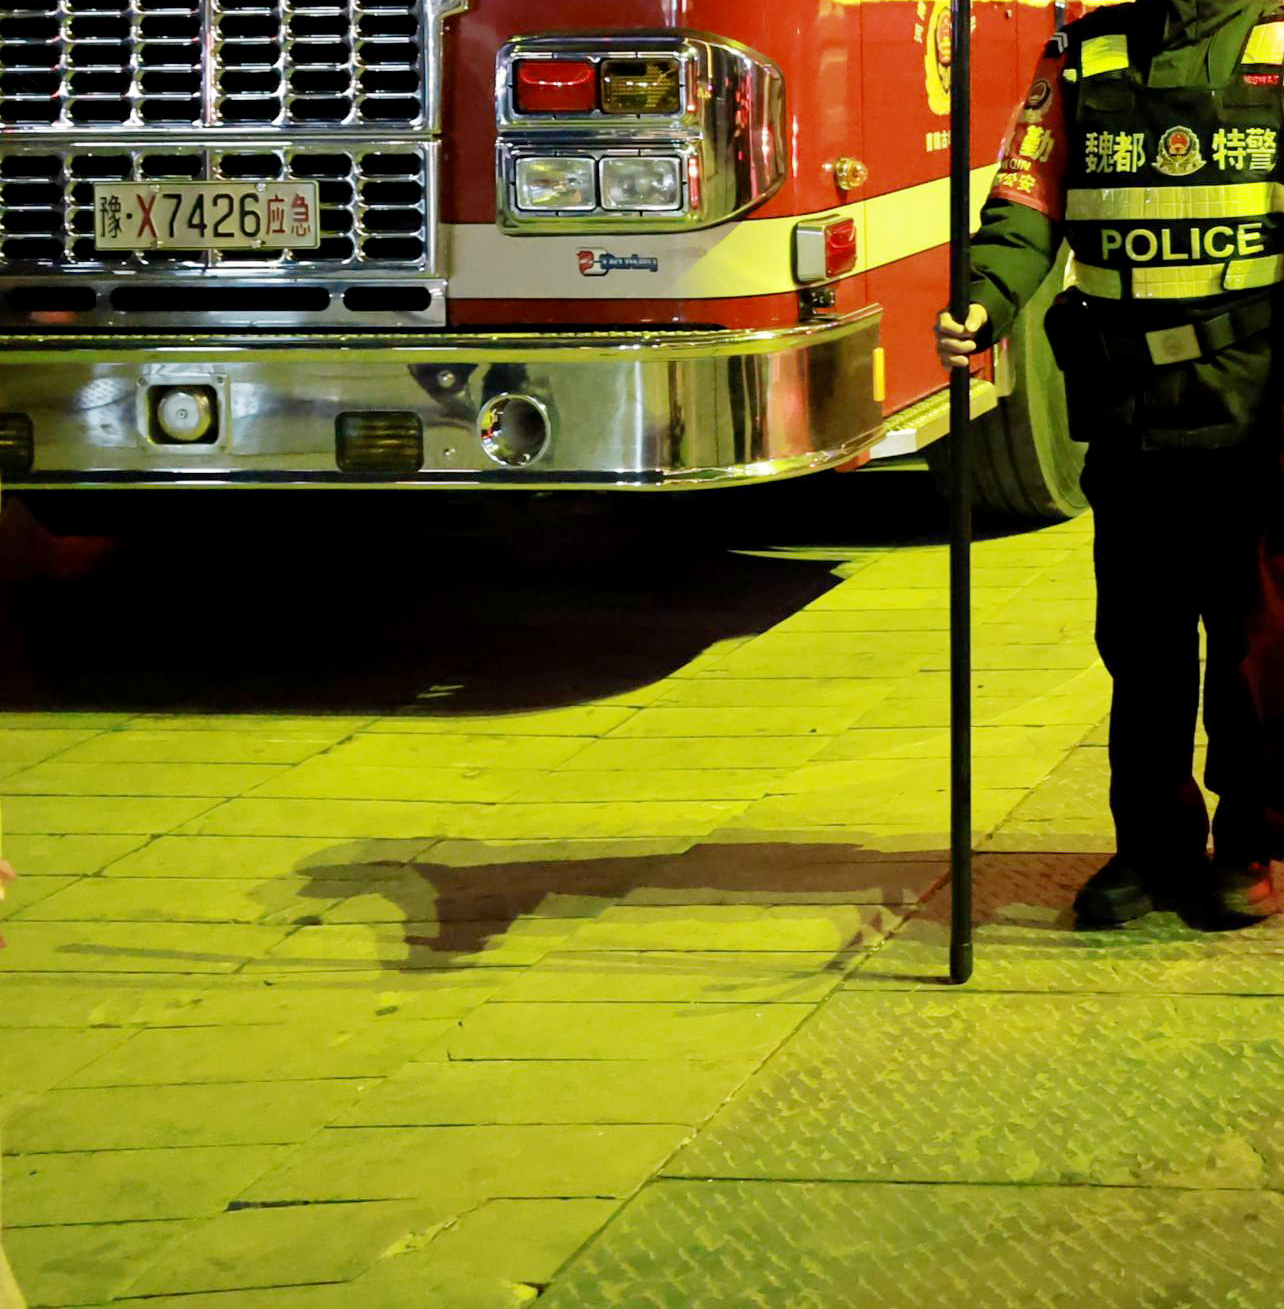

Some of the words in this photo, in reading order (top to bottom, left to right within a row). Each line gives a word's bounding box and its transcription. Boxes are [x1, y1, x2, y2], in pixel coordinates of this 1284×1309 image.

[1085, 131, 1144, 174] 魏都
[1212, 127, 1277, 173] 特警
[1102, 223, 1264, 262] POLICE
